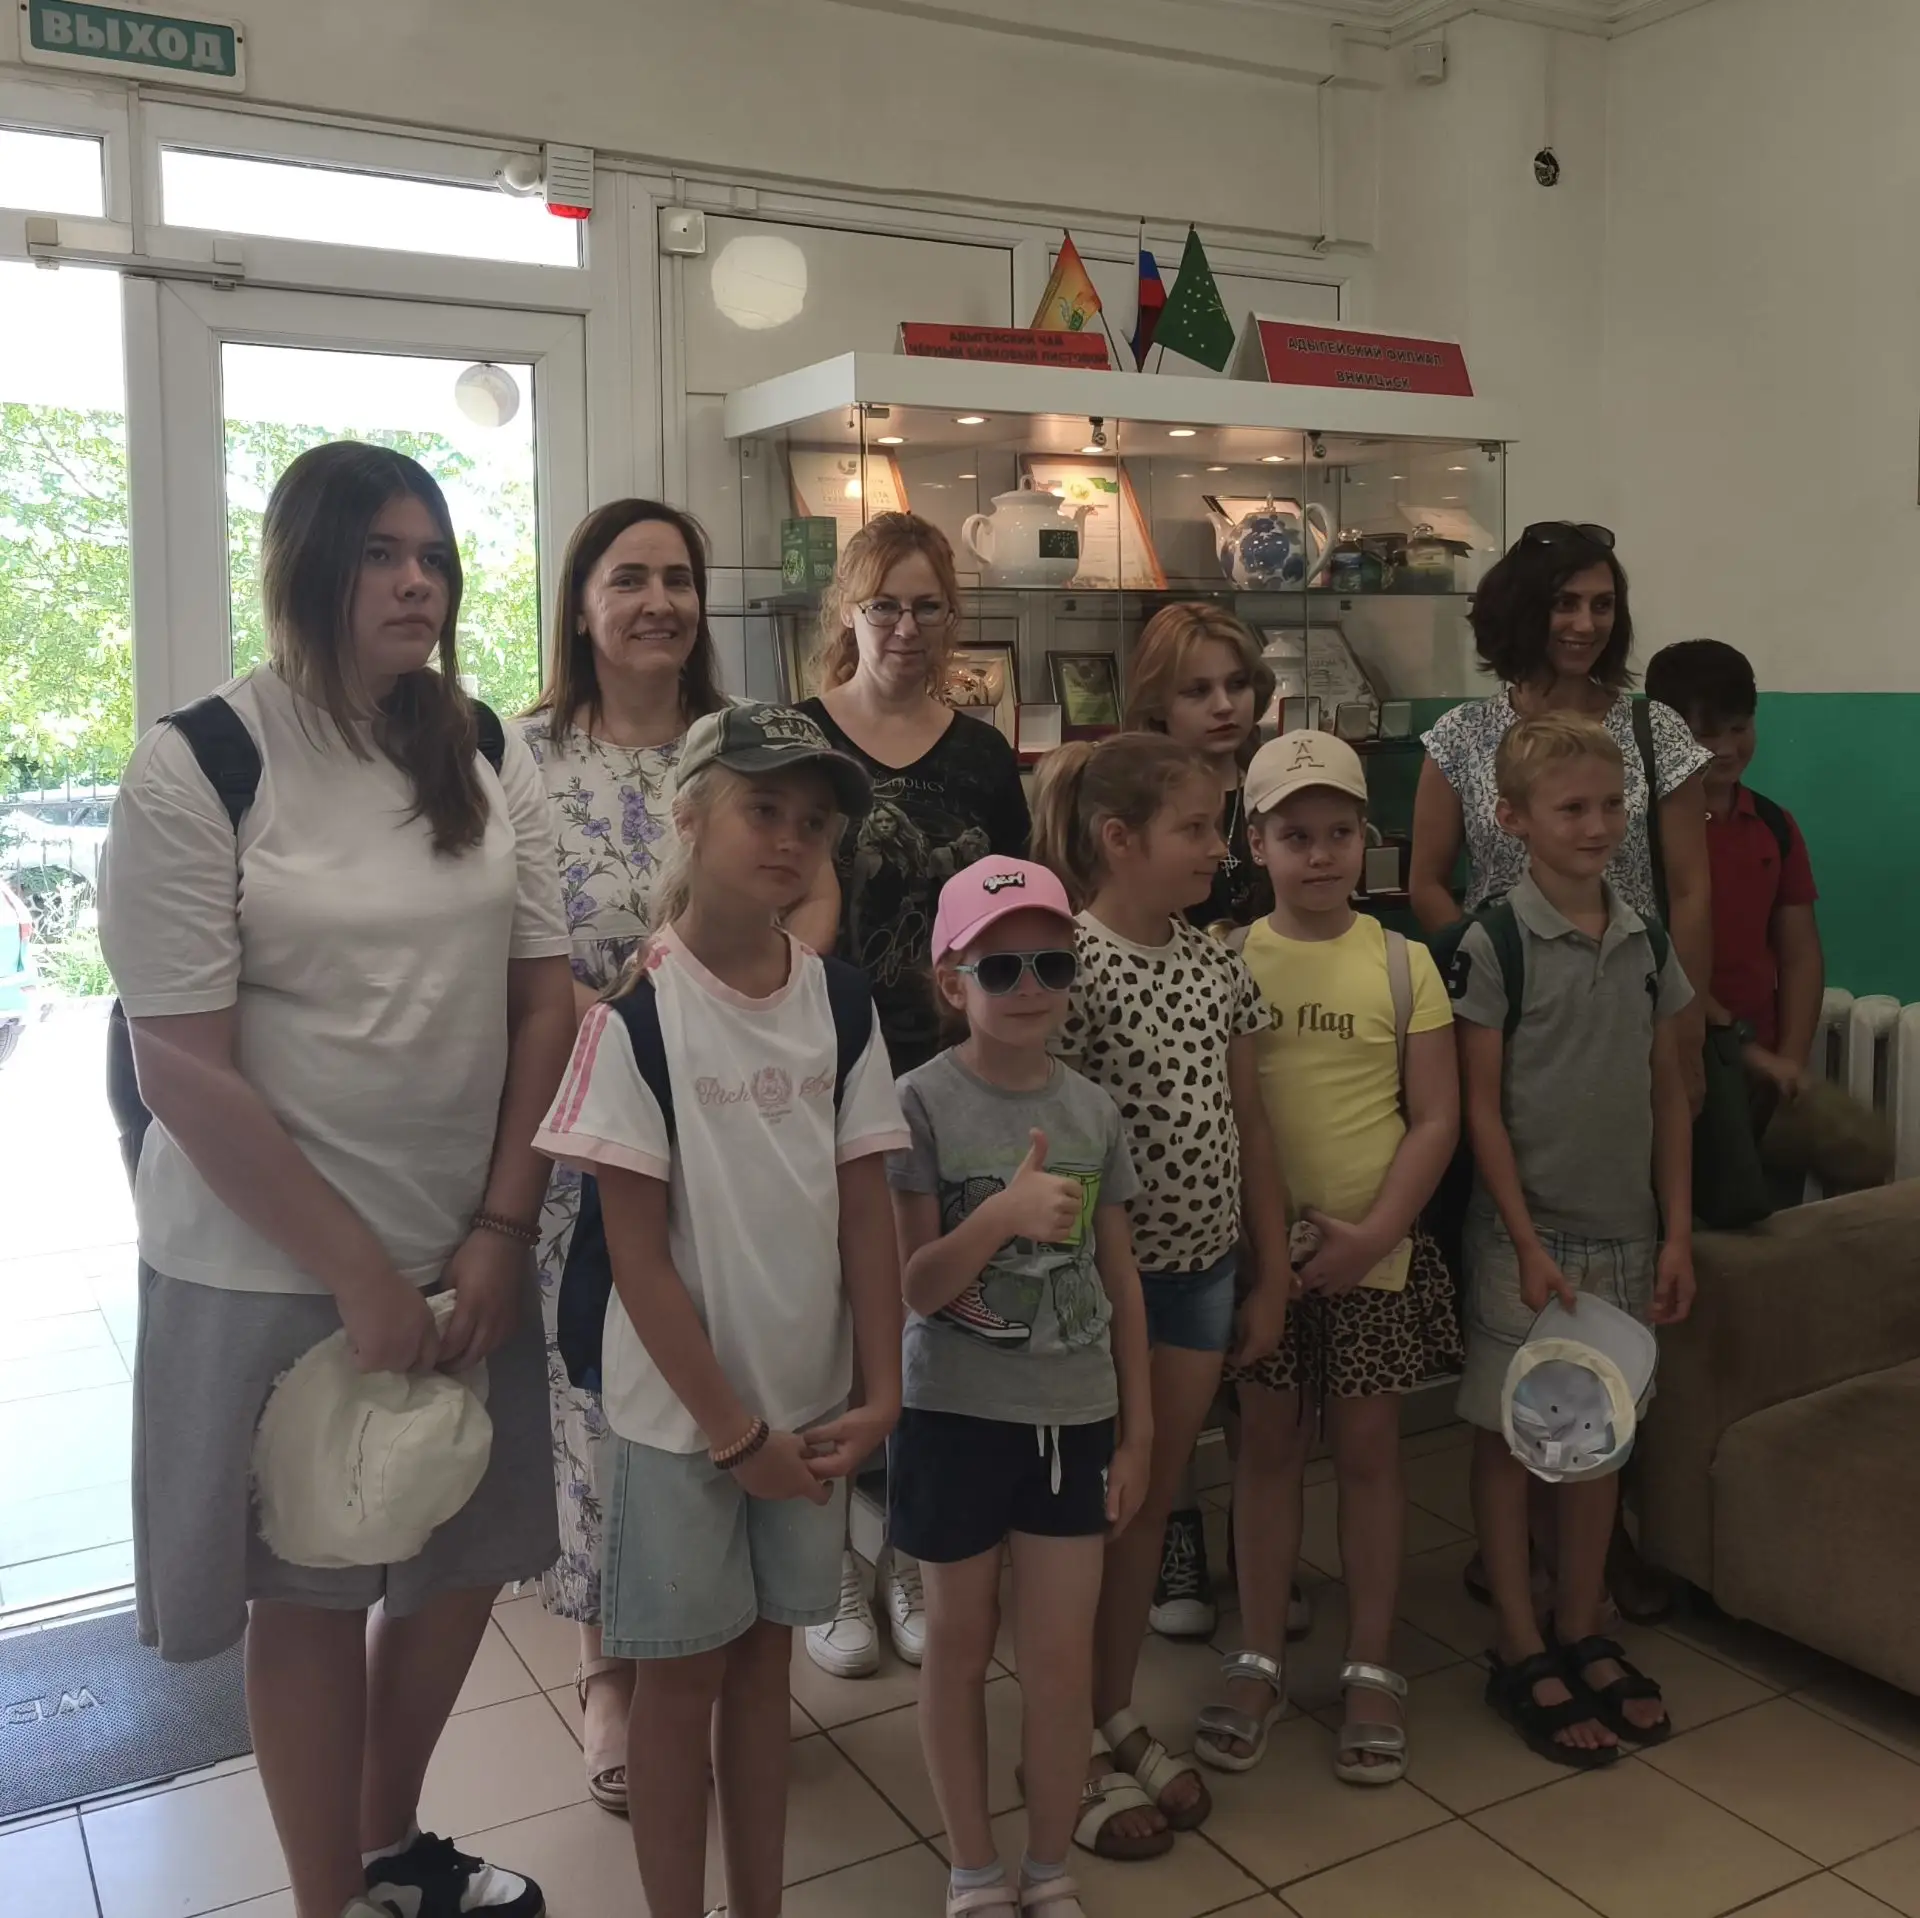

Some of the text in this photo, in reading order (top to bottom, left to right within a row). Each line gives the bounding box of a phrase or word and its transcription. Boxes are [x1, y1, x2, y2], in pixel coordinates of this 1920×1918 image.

[41, 8, 227, 71] ВЫХОД
[1287, 336, 1444, 367] АДЫГЕЙСКИЙ ФИЛИАЛ
[1297, 1002, 1356, 1040] flag
